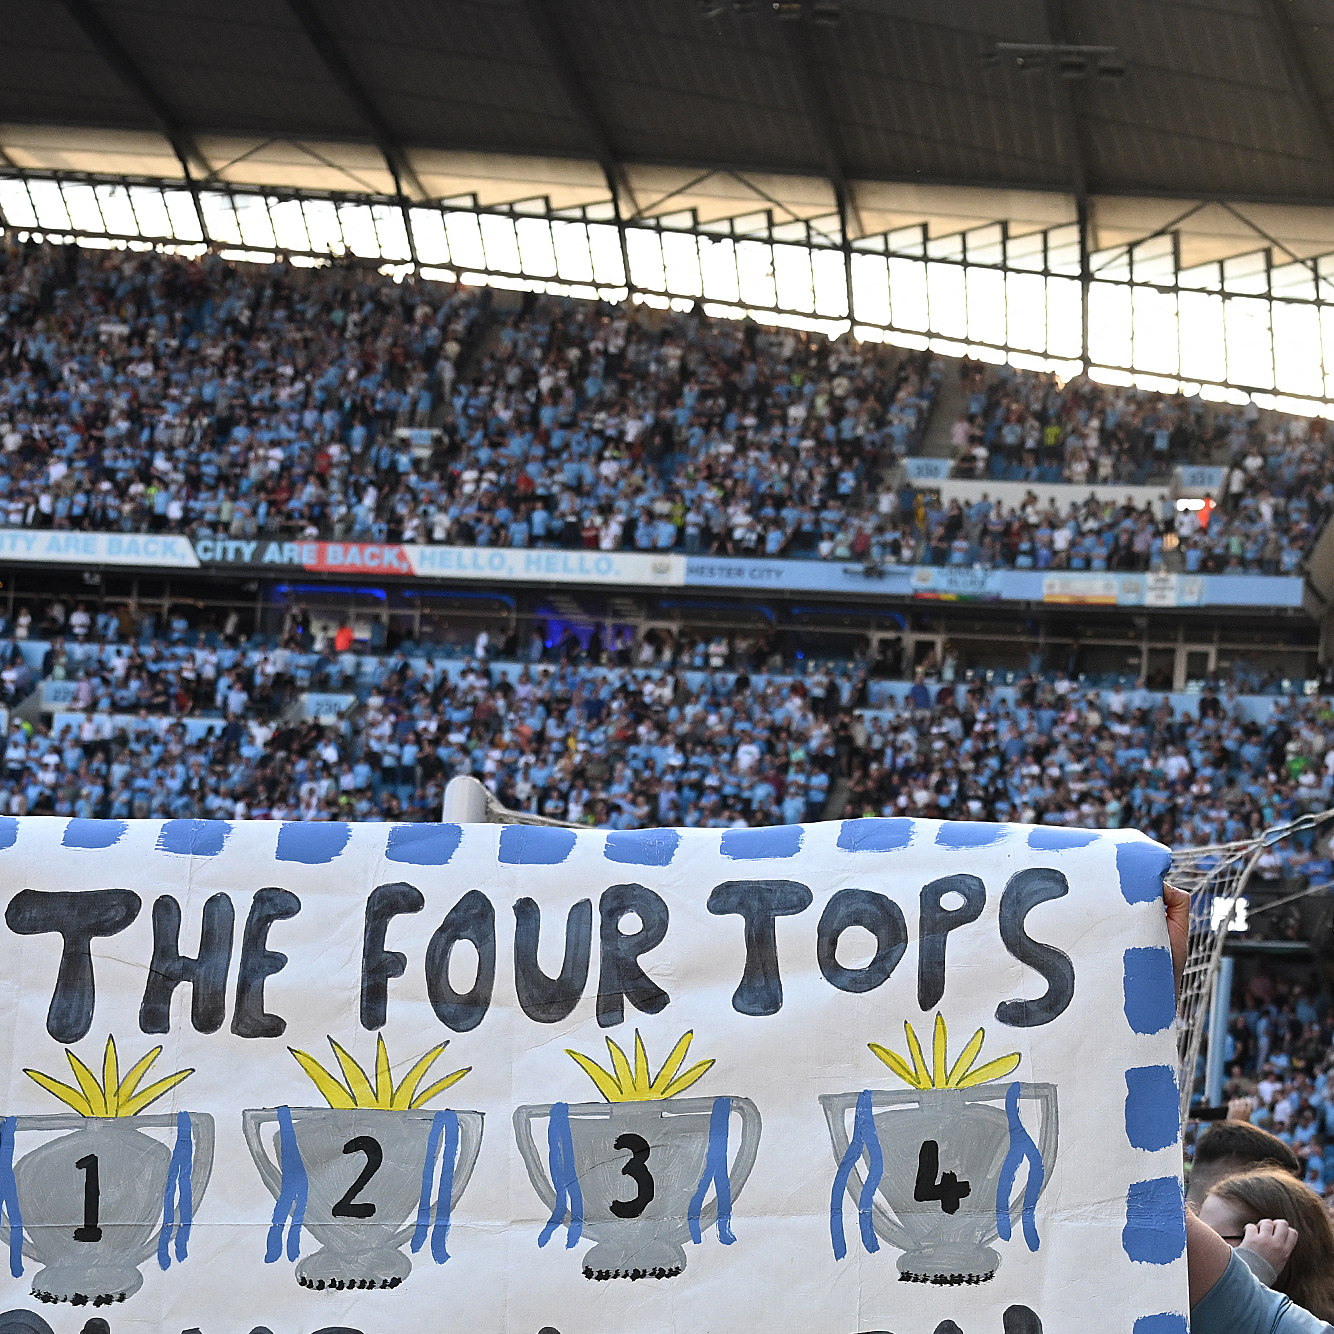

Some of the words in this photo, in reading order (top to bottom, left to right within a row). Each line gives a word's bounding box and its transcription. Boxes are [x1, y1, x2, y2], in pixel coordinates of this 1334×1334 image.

[45, 535, 99, 556] ARE
[196, 539, 258, 564] CITY
[262, 541, 316, 565] ARE
[750, 566, 784, 581] CITY
[5, 886, 302, 1044] THE
[360, 882, 671, 1032] FOUR
[706, 867, 1076, 1028] TOPS
[72, 1153, 103, 1243] 1
[331, 1135, 384, 1220] 2
[608, 1132, 655, 1220] 3
[913, 1139, 972, 1219] 4
